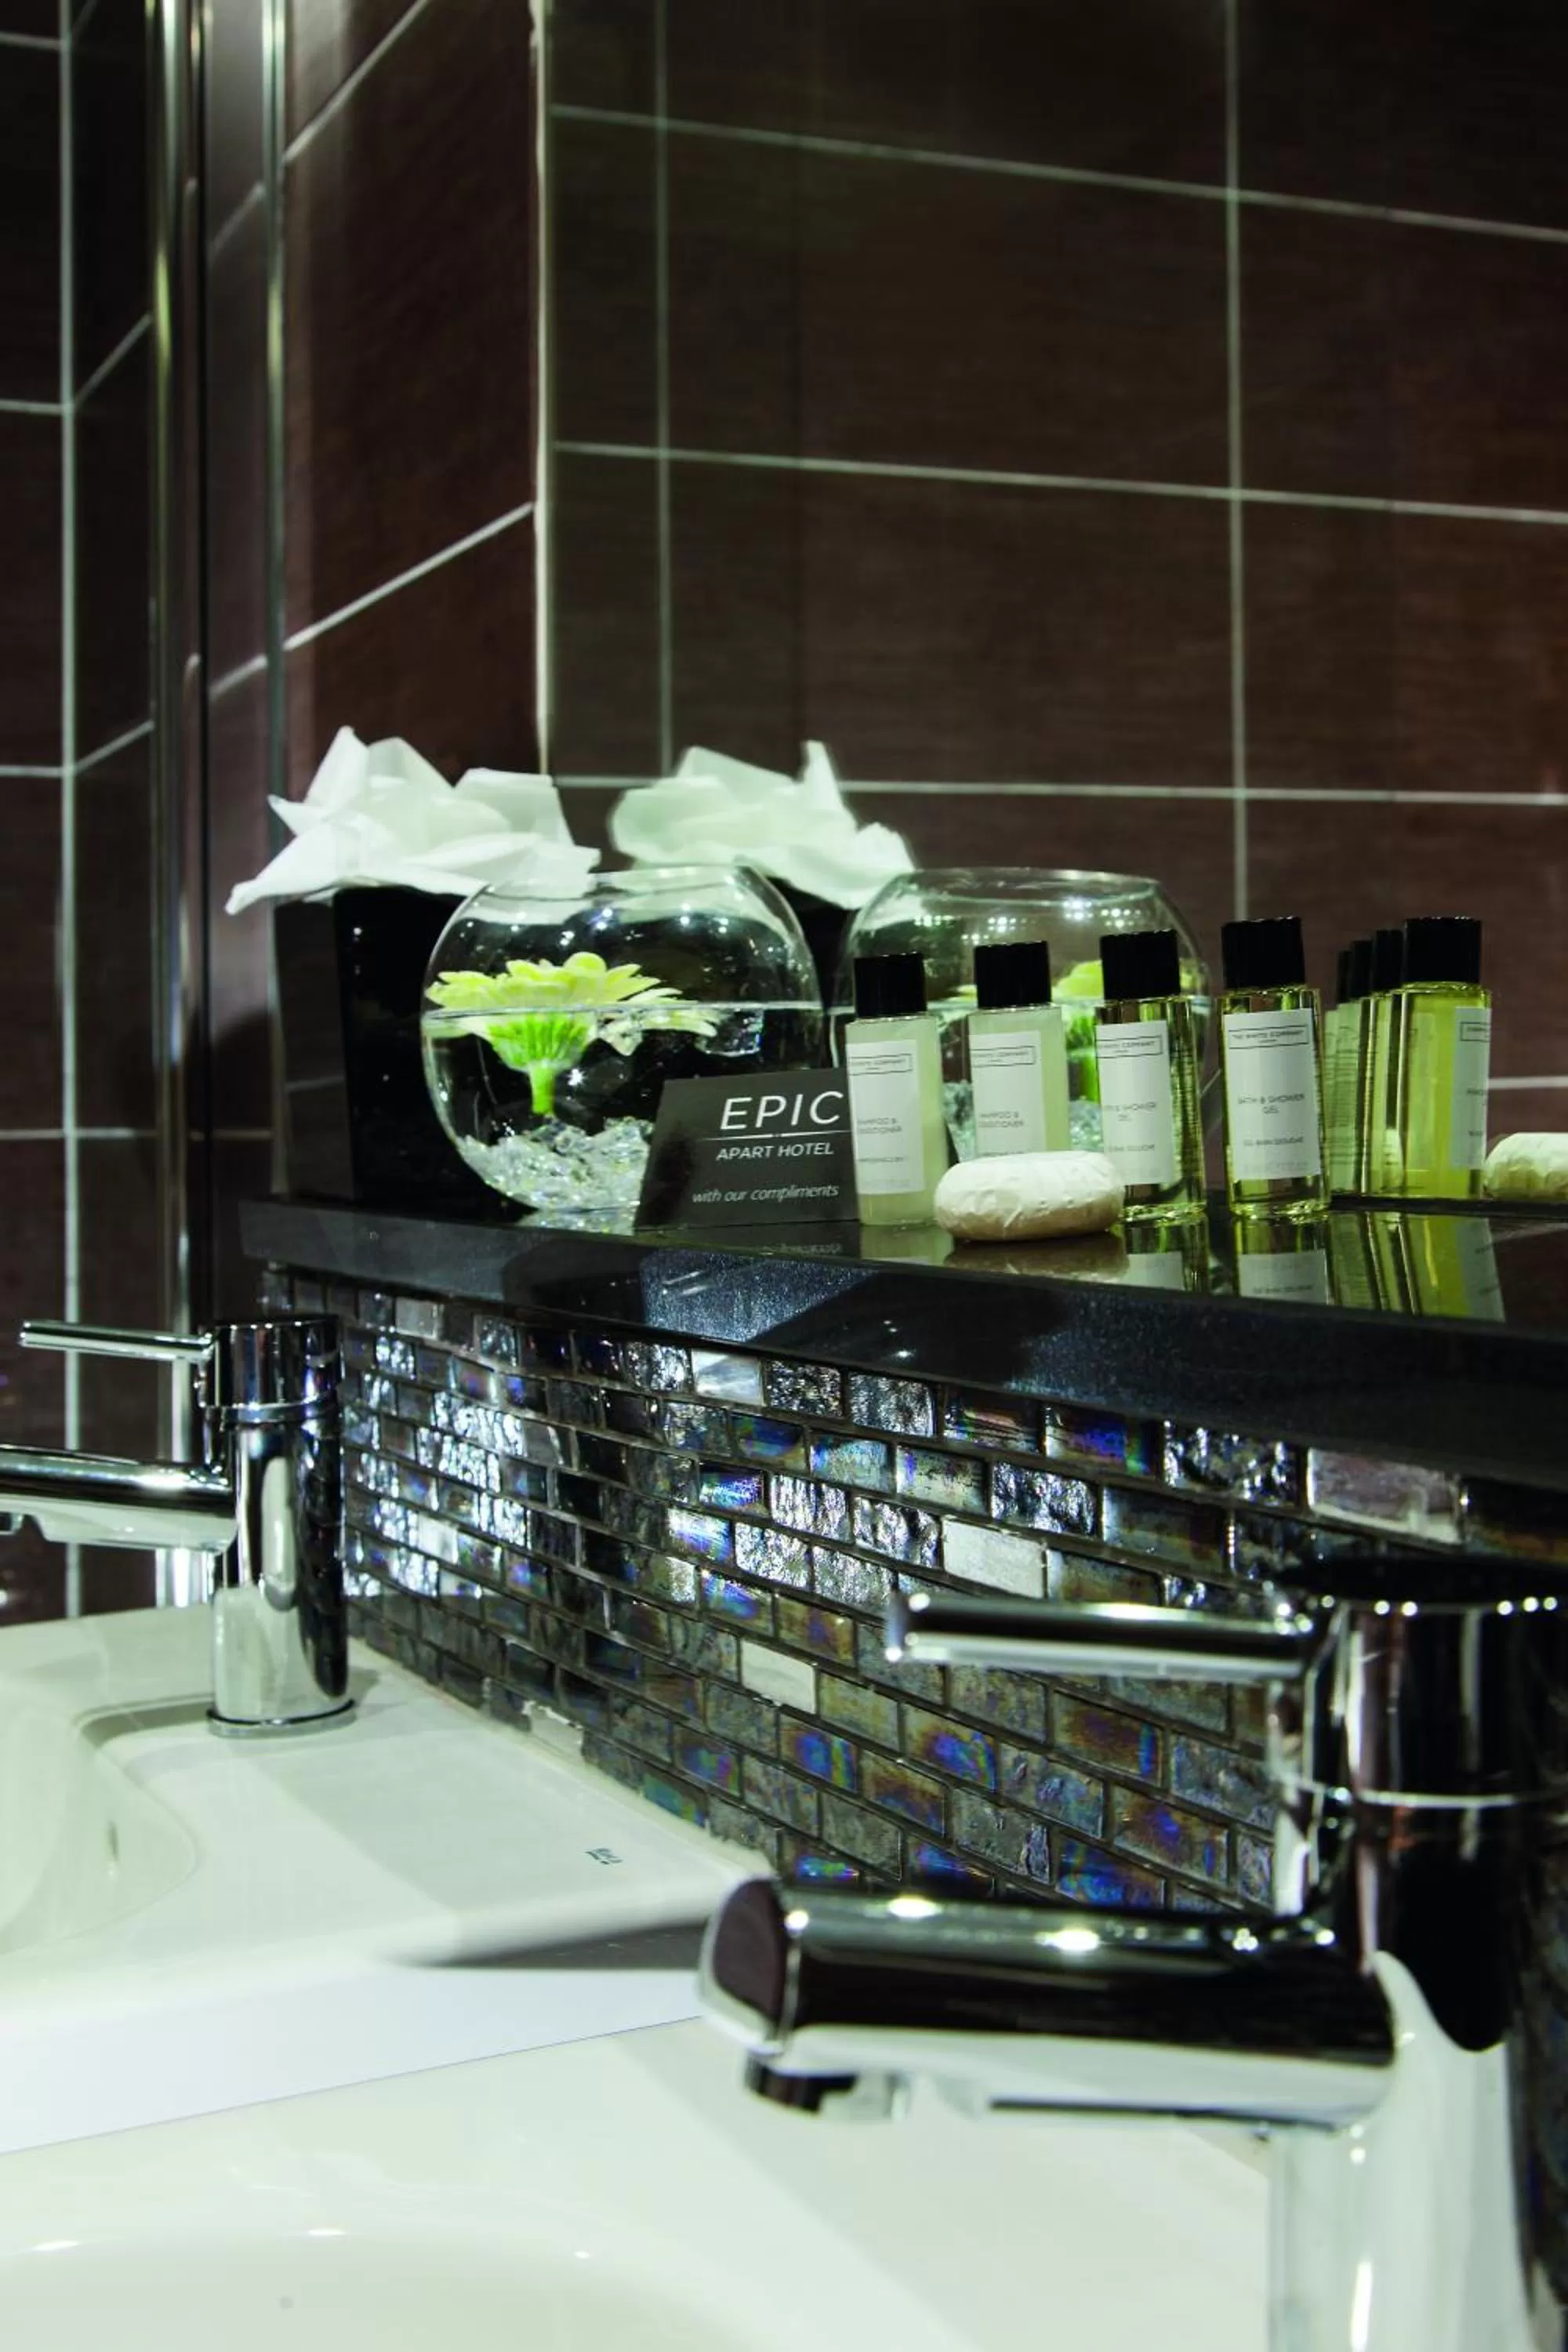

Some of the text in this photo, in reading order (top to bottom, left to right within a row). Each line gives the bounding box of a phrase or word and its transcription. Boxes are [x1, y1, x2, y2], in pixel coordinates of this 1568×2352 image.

[720, 1091, 844, 1130] EPIC
[714, 1142, 835, 1162] APART HOTEL
[691, 1184, 840, 1203] with our compliments
